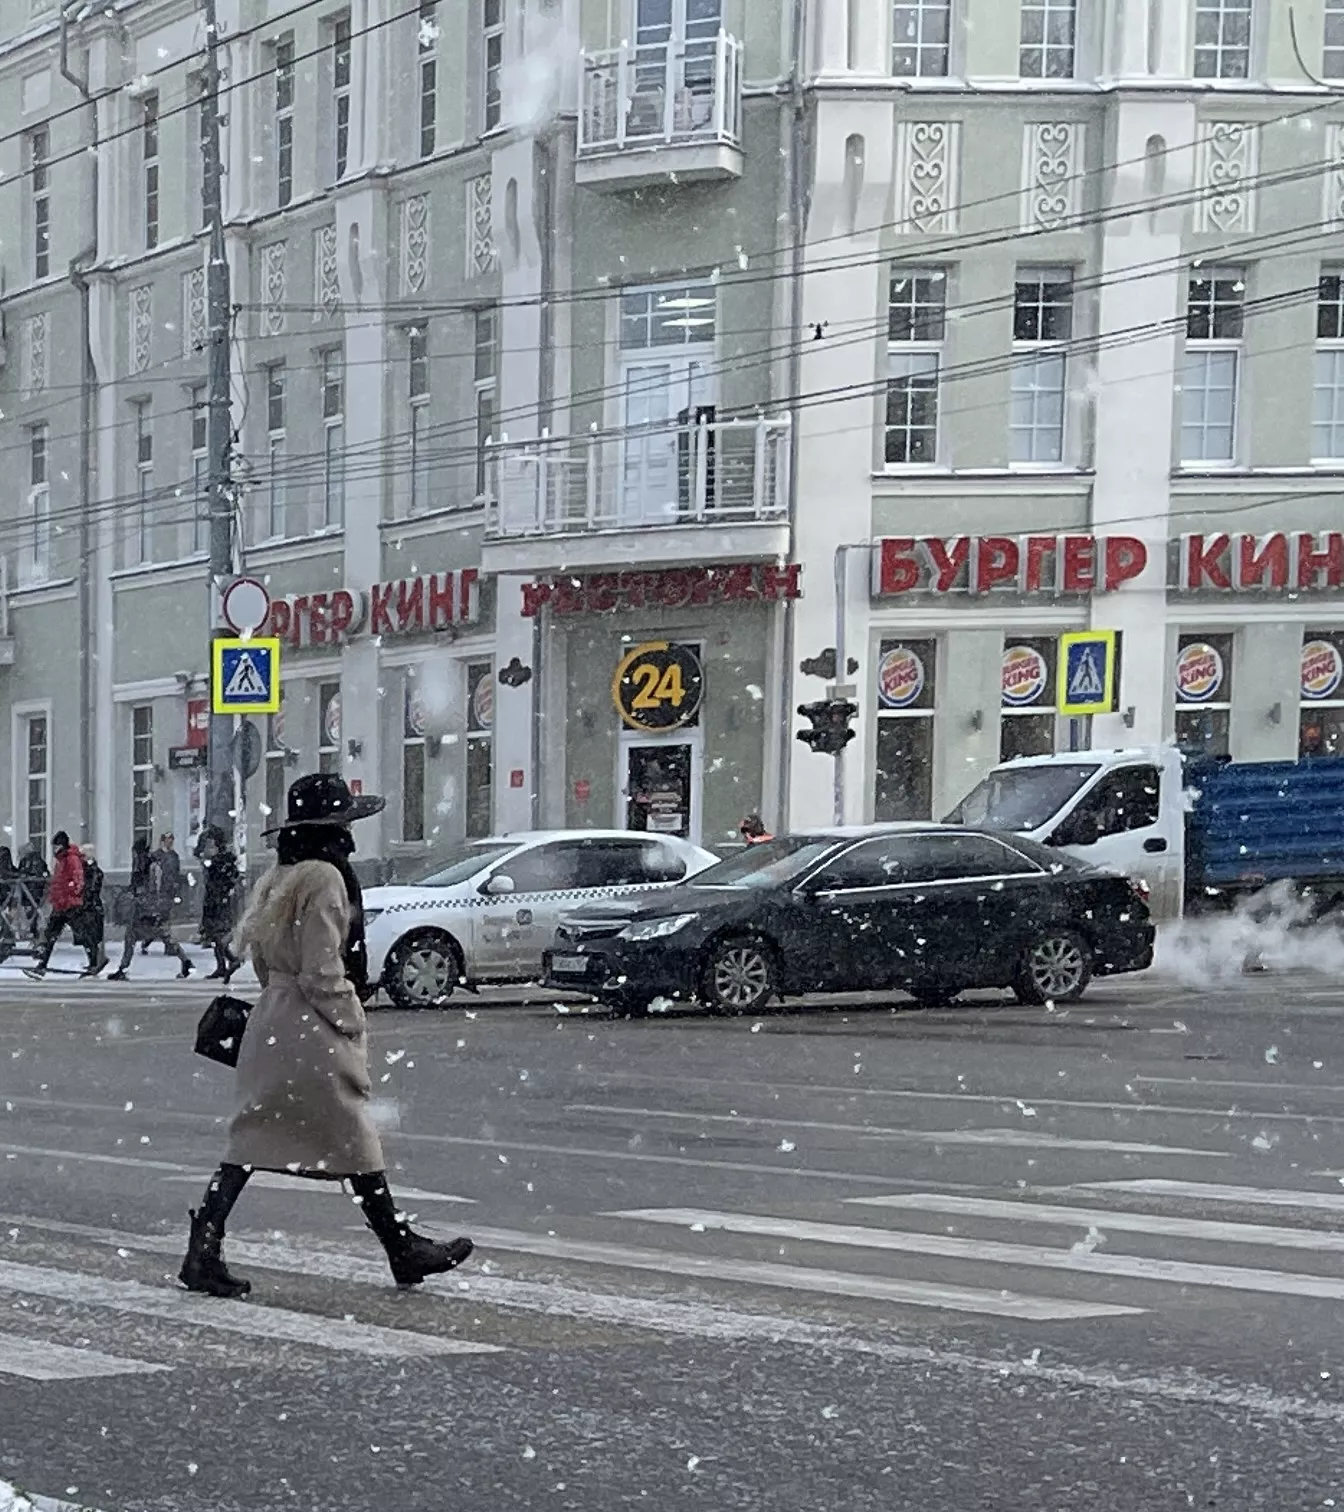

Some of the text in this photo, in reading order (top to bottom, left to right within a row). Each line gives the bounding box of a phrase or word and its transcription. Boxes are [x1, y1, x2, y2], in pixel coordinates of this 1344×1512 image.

[880, 536, 1148, 593] БУРГЕР
[270, 568, 479, 648] РГЕР КИНГ
[631, 663, 686, 709] 24
[884, 668, 918, 693] KING
[1002, 666, 1040, 689] KING
[1179, 664, 1217, 688] KING
